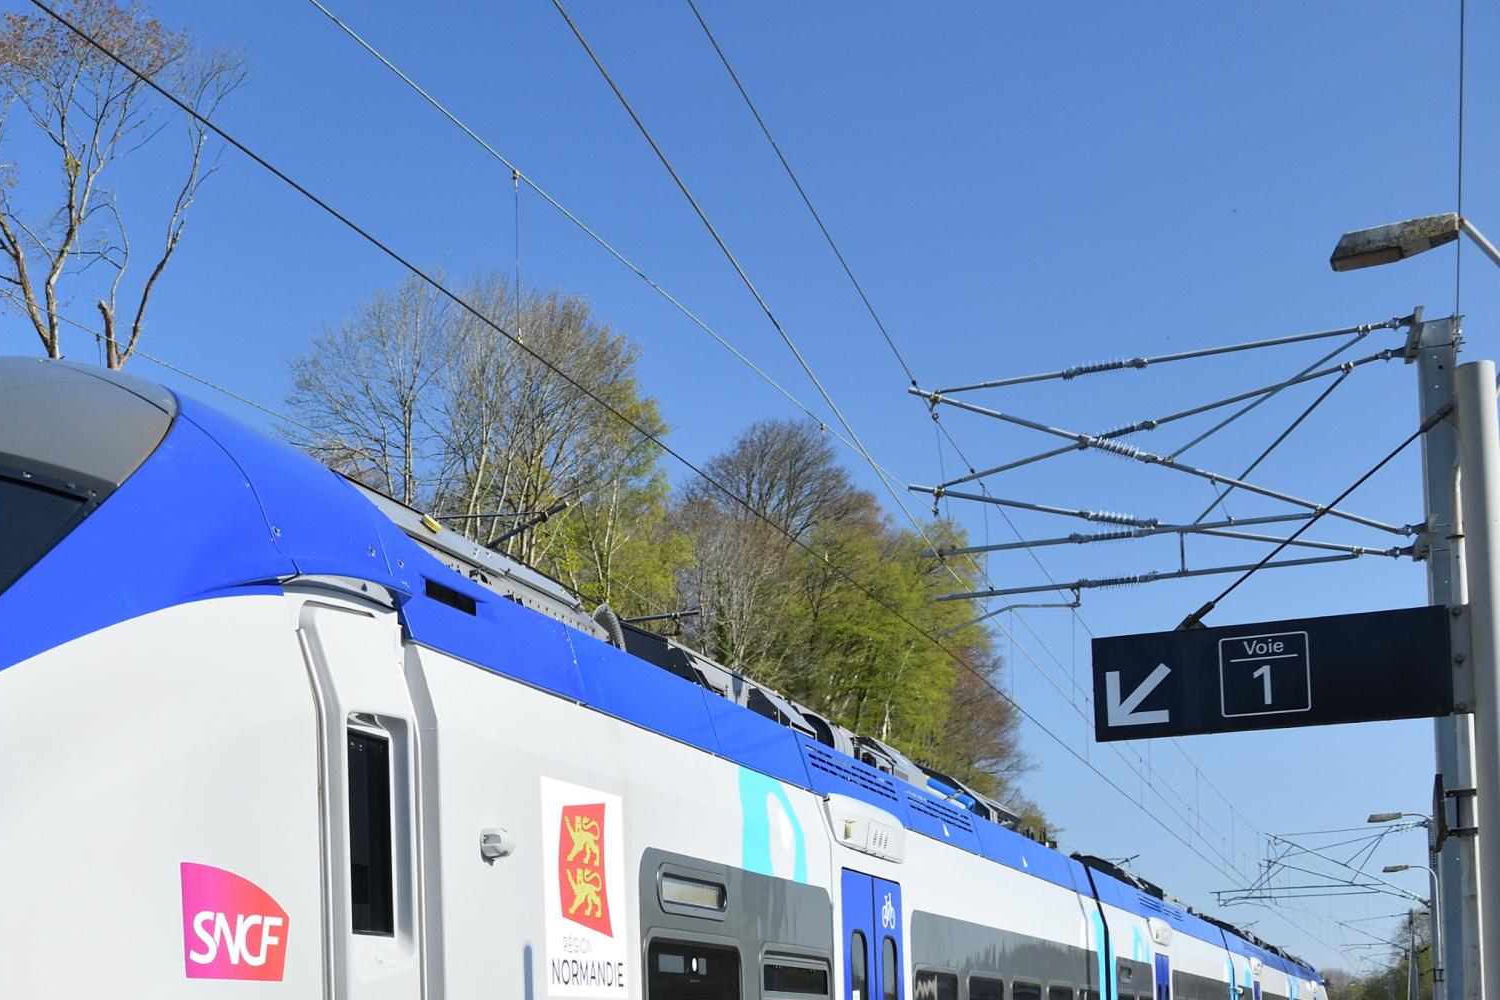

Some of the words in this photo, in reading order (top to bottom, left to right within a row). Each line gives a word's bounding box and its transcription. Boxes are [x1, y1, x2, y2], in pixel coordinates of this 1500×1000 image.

[1243, 638, 1285, 655] Voie
[1253, 664, 1273, 705] 1
[189, 910, 284, 967] SNCF
[562, 933, 593, 954] RÉGION
[551, 958, 624, 988] NORMANDIE
